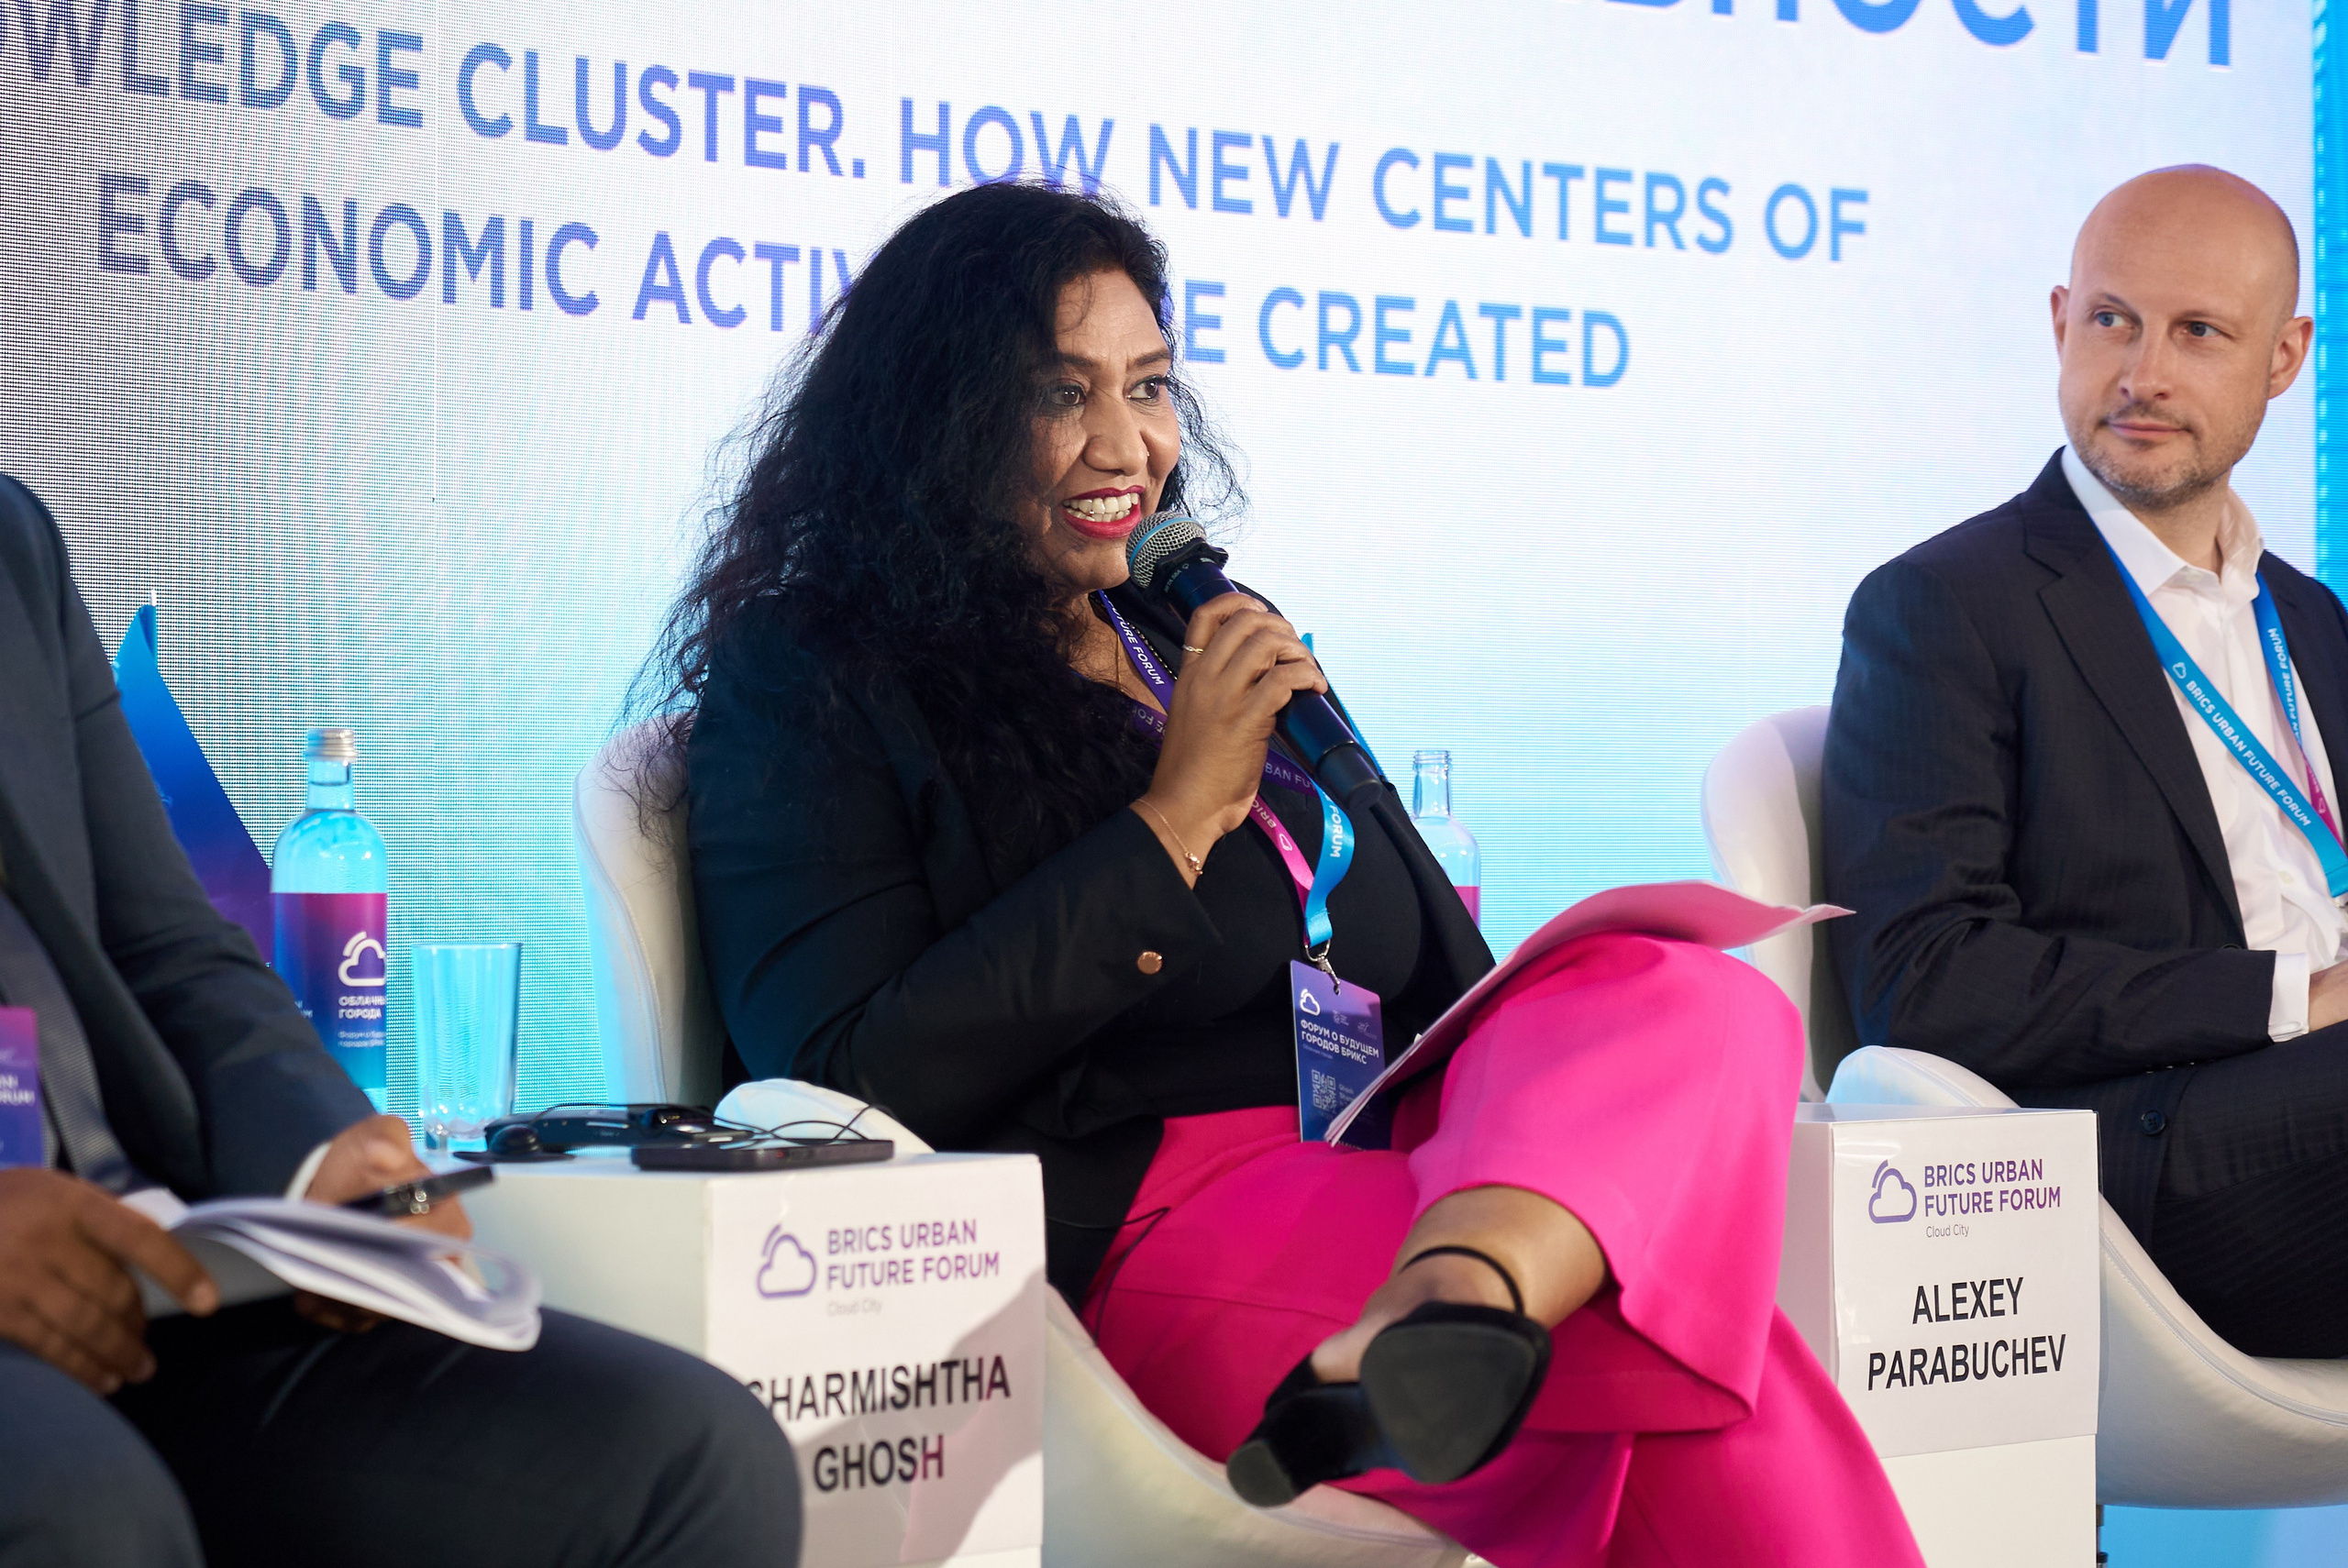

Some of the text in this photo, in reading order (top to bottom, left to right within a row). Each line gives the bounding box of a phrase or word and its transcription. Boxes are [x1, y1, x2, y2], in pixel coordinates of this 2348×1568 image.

[0, 0, 1869, 262] WLEDGE CLUSTER. HOW NEW CENTERS OF
[98, 172, 601, 316] ECONOMIC
[1259, 286, 1631, 388] CREATED
[1133, 646, 1165, 685] FORUM
[2267, 628, 2288, 669] FORUM
[1266, 762, 1291, 781] BAN
[2186, 680, 2311, 826] BRICS URBAN FUTURE FORUM
[1252, 799, 1277, 828] BRIC
[1329, 804, 1343, 858] FORUM
[338, 996, 386, 1006] ОБЛАЧНЫ
[338, 1008, 382, 1020] ГОРОДА
[1301, 1020, 1330, 1038] ФОРУМ
[1332, 1032, 1338, 1042] О
[1339, 1034, 1379, 1058] БУДУЩЕМ
[1301, 1031, 1339, 1054] ГОРОДОВ
[1341, 1046, 1367, 1065] БРИКС
[1924, 1159, 2043, 1187] BRICS URBAN
[1925, 1187, 2061, 1217] FUTURE FORUM
[827, 1220, 977, 1255] BRICS URBAN
[1926, 1224, 1969, 1238] Cloud City
[827, 1252, 1000, 1290] FUTURE FORUM
[827, 1297, 881, 1316] Cloud City
[1912, 1276, 2023, 1324] ALEXEY
[1867, 1334, 2066, 1390] PARABUCHEV
[814, 1433, 944, 1492] GHOSH
